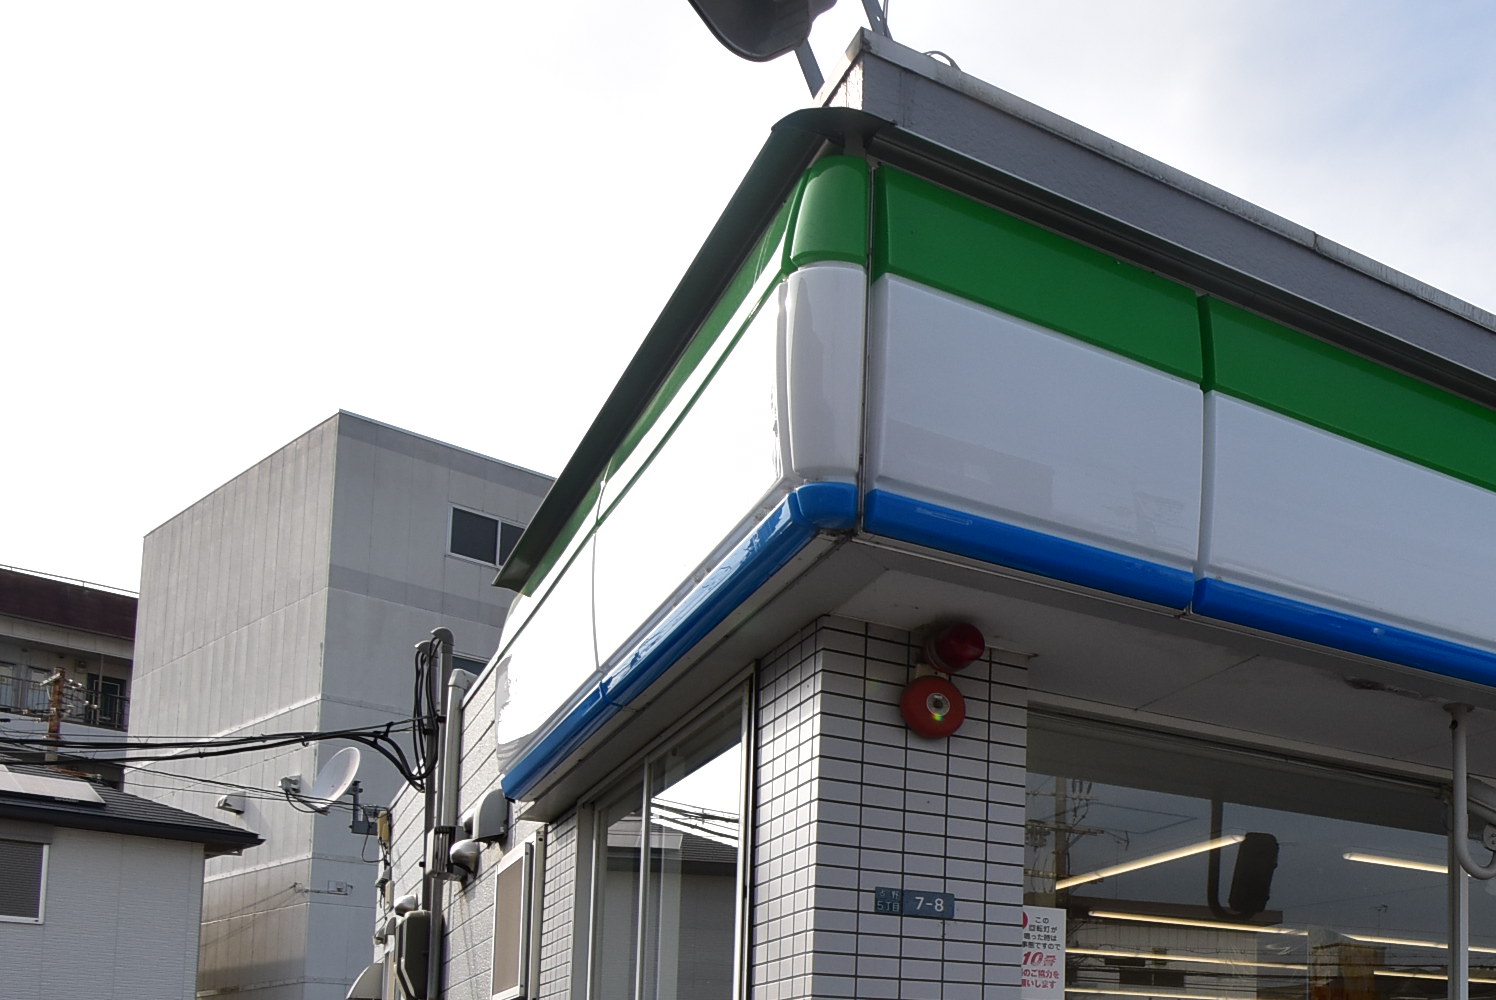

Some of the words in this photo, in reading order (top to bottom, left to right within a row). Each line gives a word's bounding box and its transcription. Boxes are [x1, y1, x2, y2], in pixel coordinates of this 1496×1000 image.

[877, 900, 900, 912] 5丁目
[914, 896, 944, 912] 7-8
[1035, 916, 1050, 924] この
